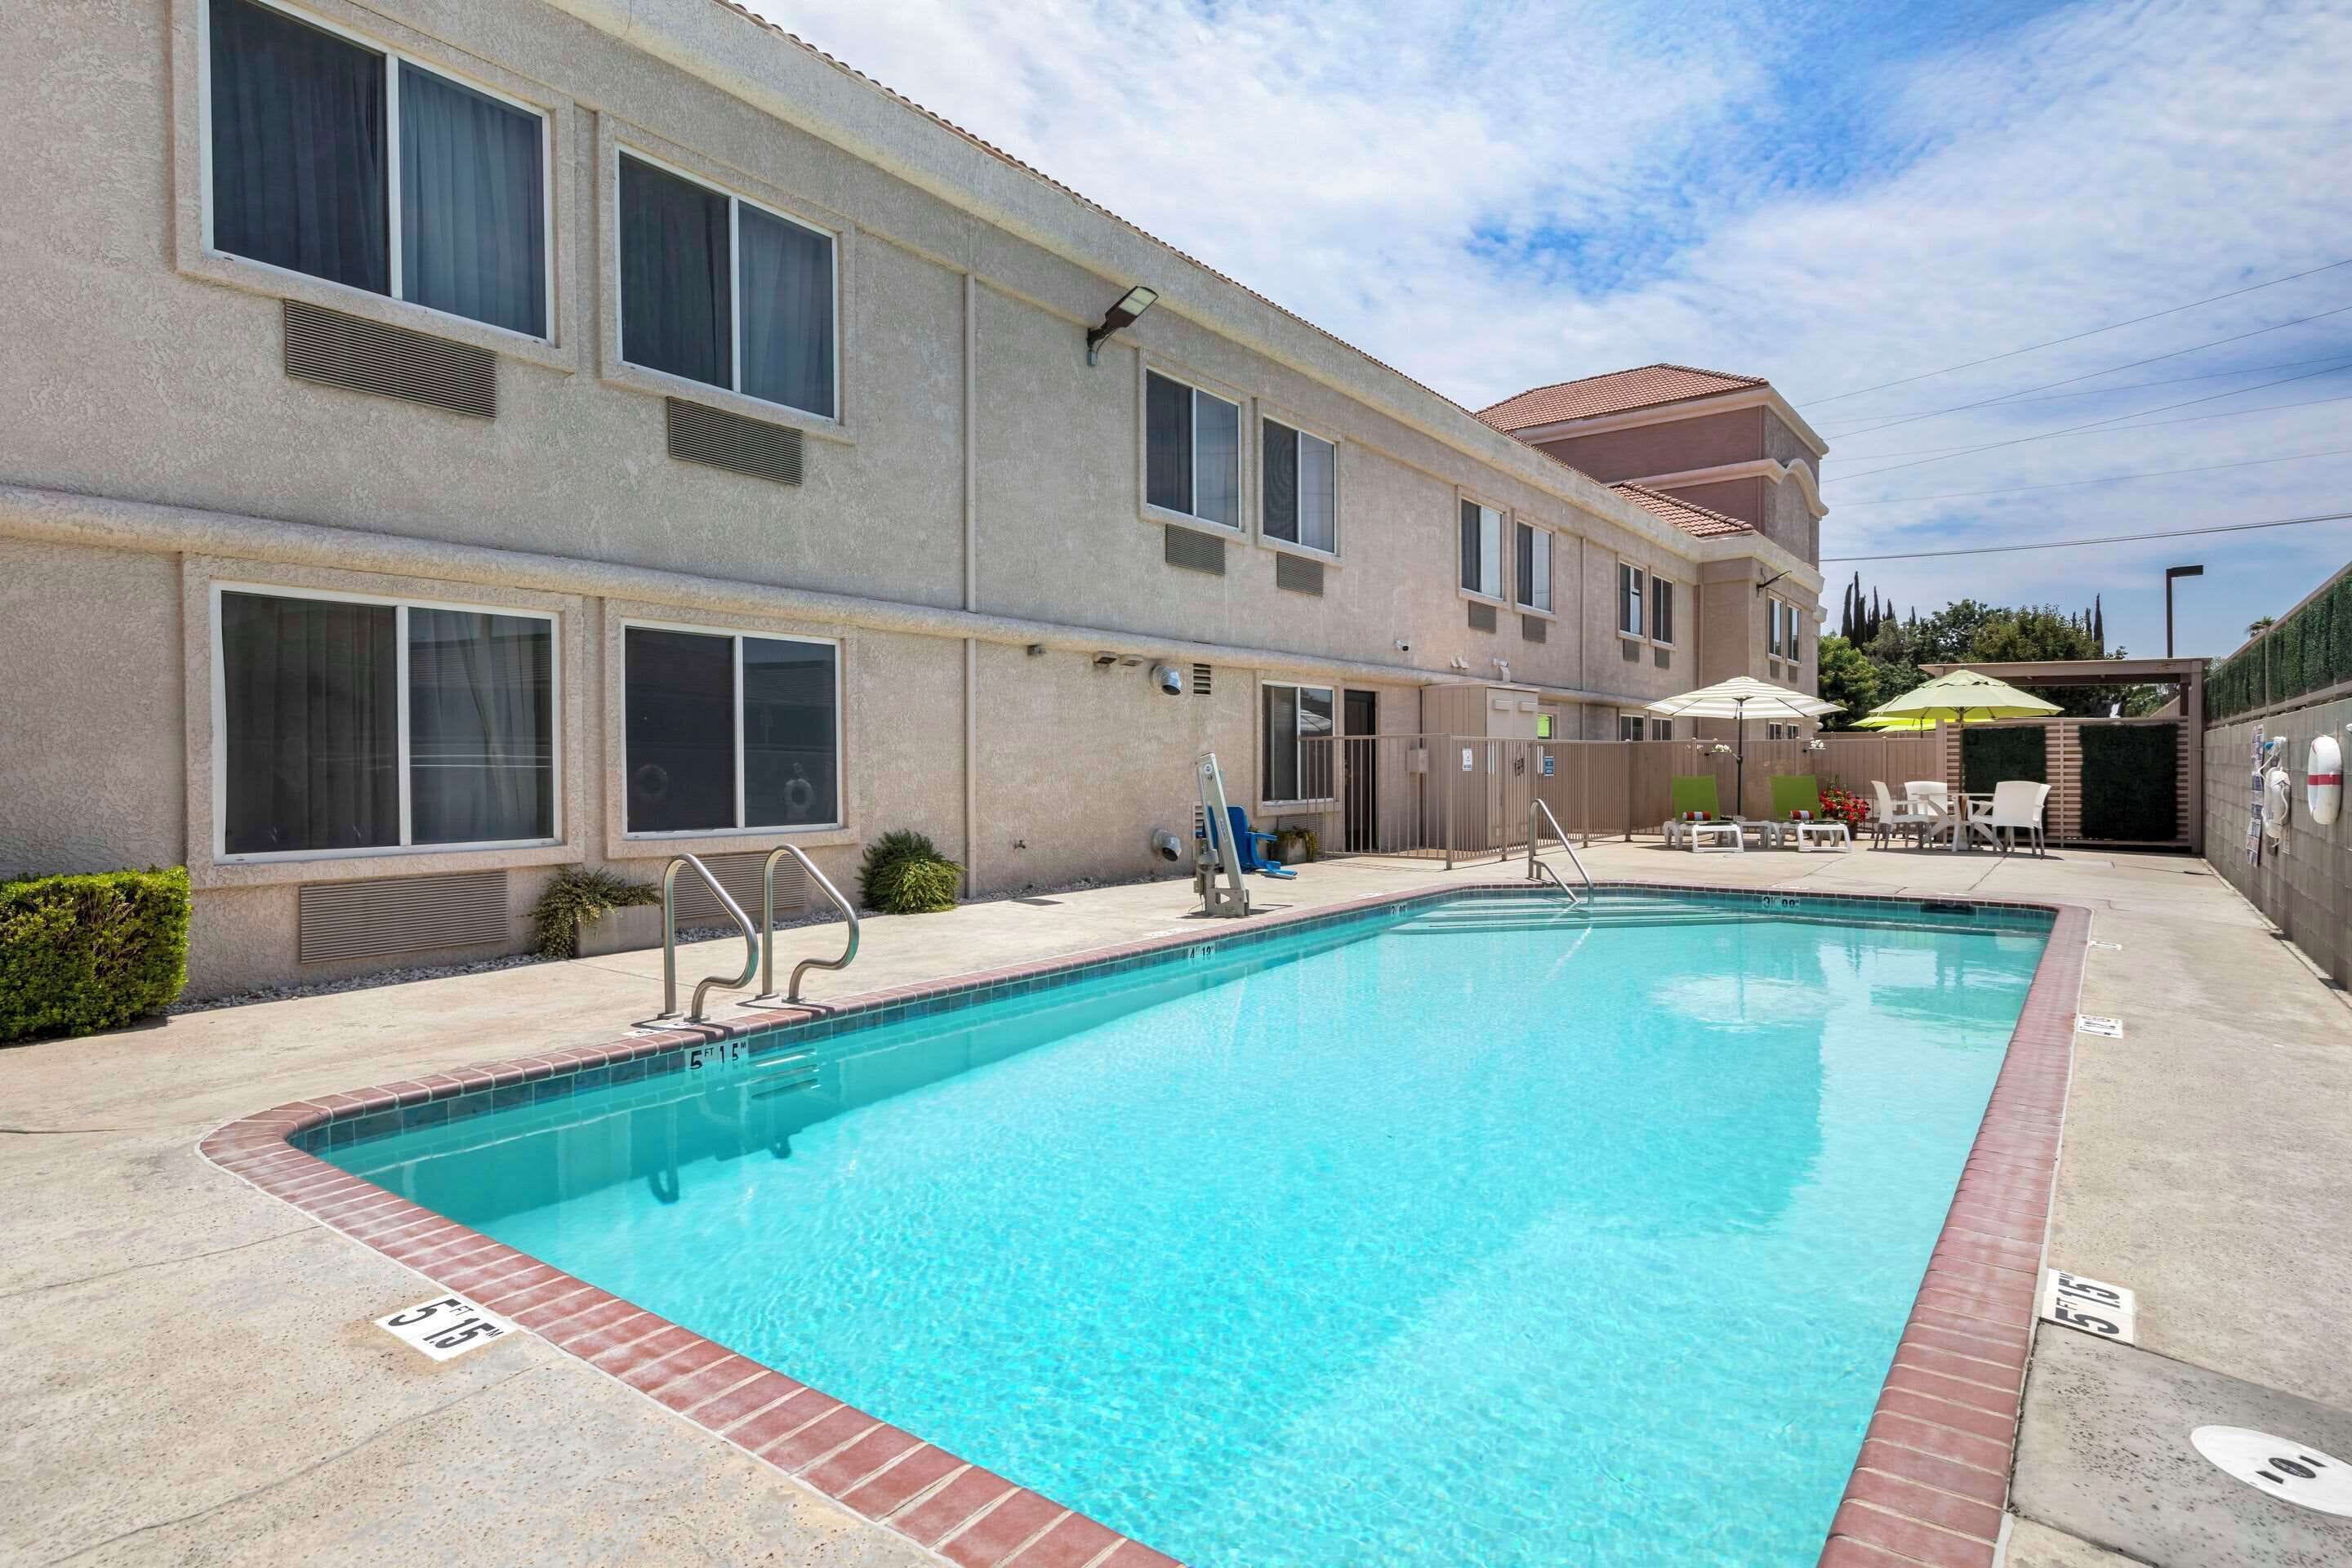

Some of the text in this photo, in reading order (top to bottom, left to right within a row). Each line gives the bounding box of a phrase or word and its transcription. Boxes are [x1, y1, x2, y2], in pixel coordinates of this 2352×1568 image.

[690, 1050, 702, 1070] 5
[705, 1047, 714, 1057] FT
[388, 1298, 461, 1327] 5
[451, 1304, 474, 1316] FT
[488, 1329, 504, 1339] M
[2055, 1307, 2120, 1334] 5
